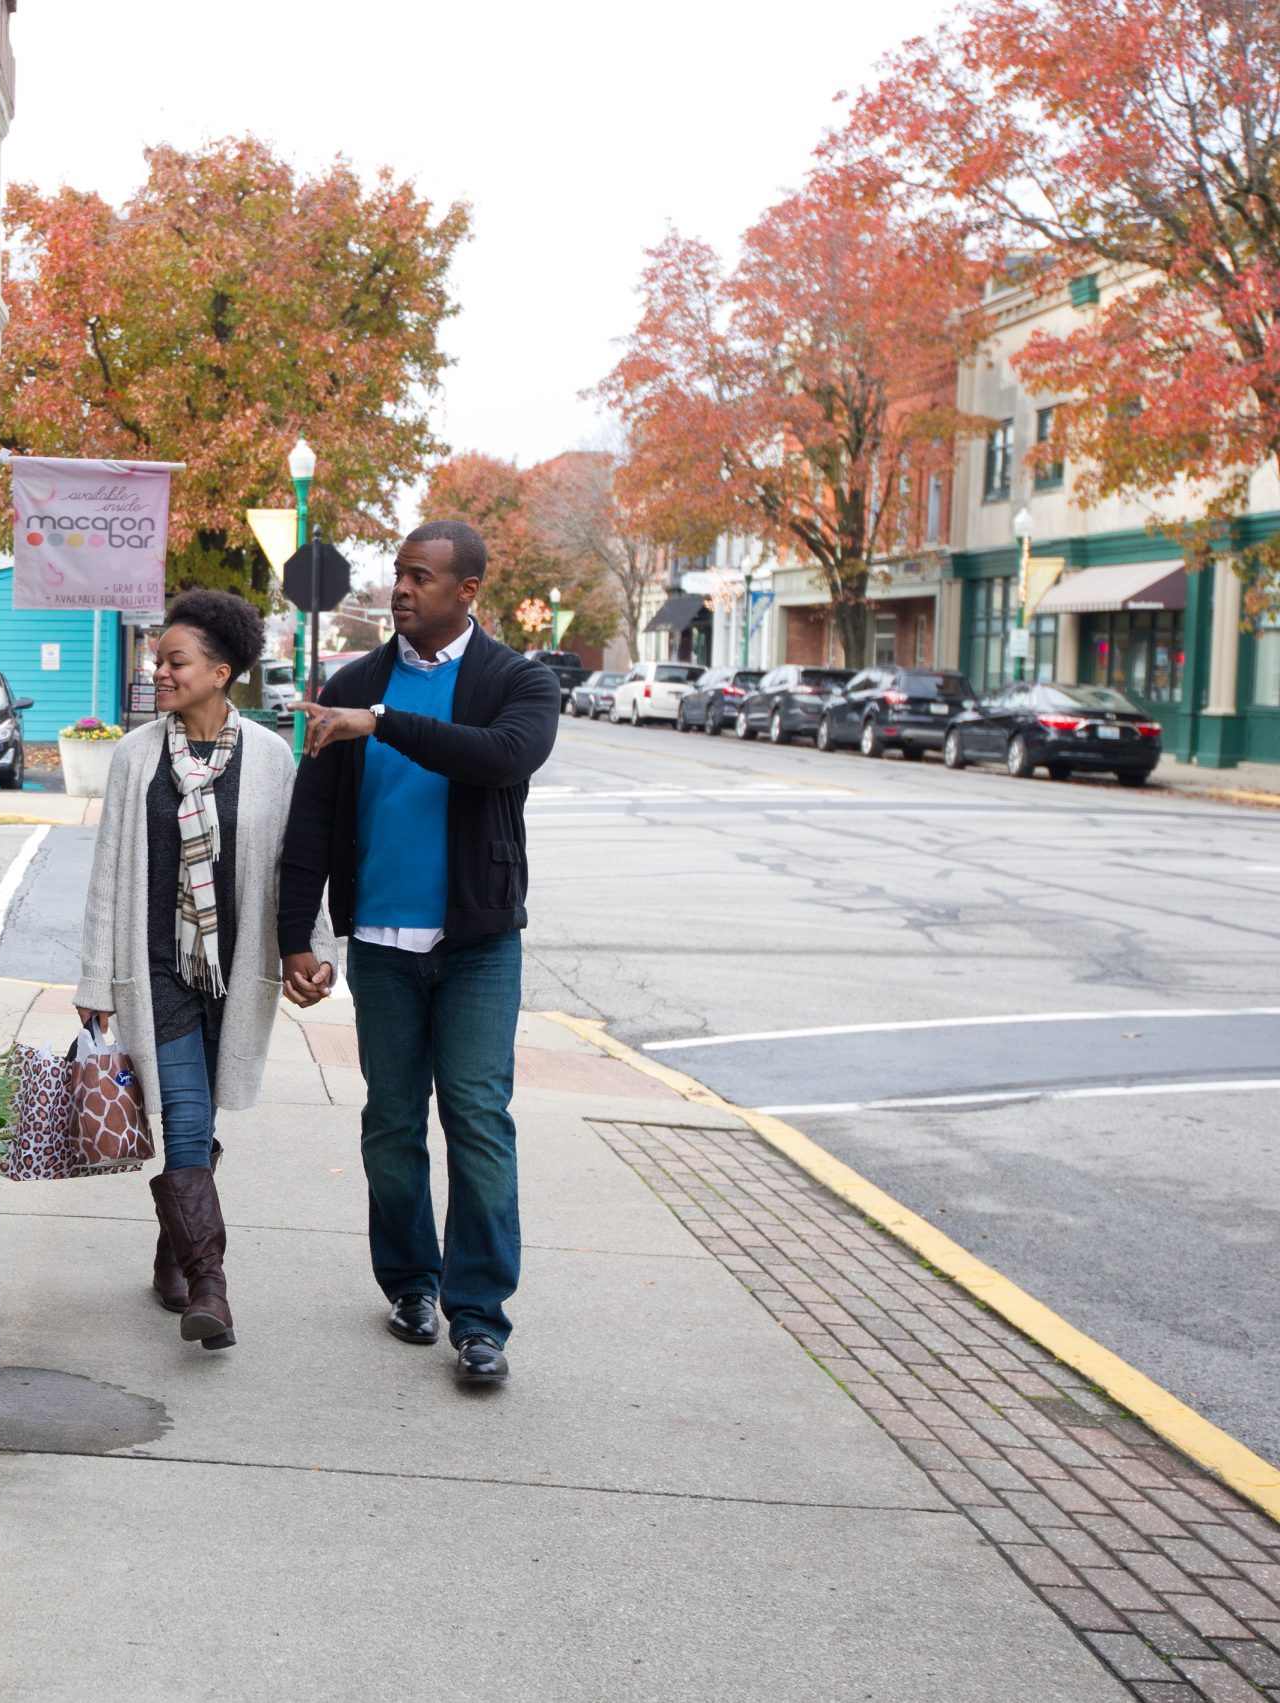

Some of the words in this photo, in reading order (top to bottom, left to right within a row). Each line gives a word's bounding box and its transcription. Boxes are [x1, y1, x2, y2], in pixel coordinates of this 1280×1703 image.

[61, 486, 137, 501] available
[94, 497, 151, 512] inside
[27, 515, 155, 531] macaron
[113, 584, 134, 594] GRAB
[137, 584, 143, 593] &
[147, 583, 158, 593] GO
[55, 595, 97, 604] AVAILABLE
[101, 595, 117, 604] FOR
[121, 595, 158, 605] DELIVERY
